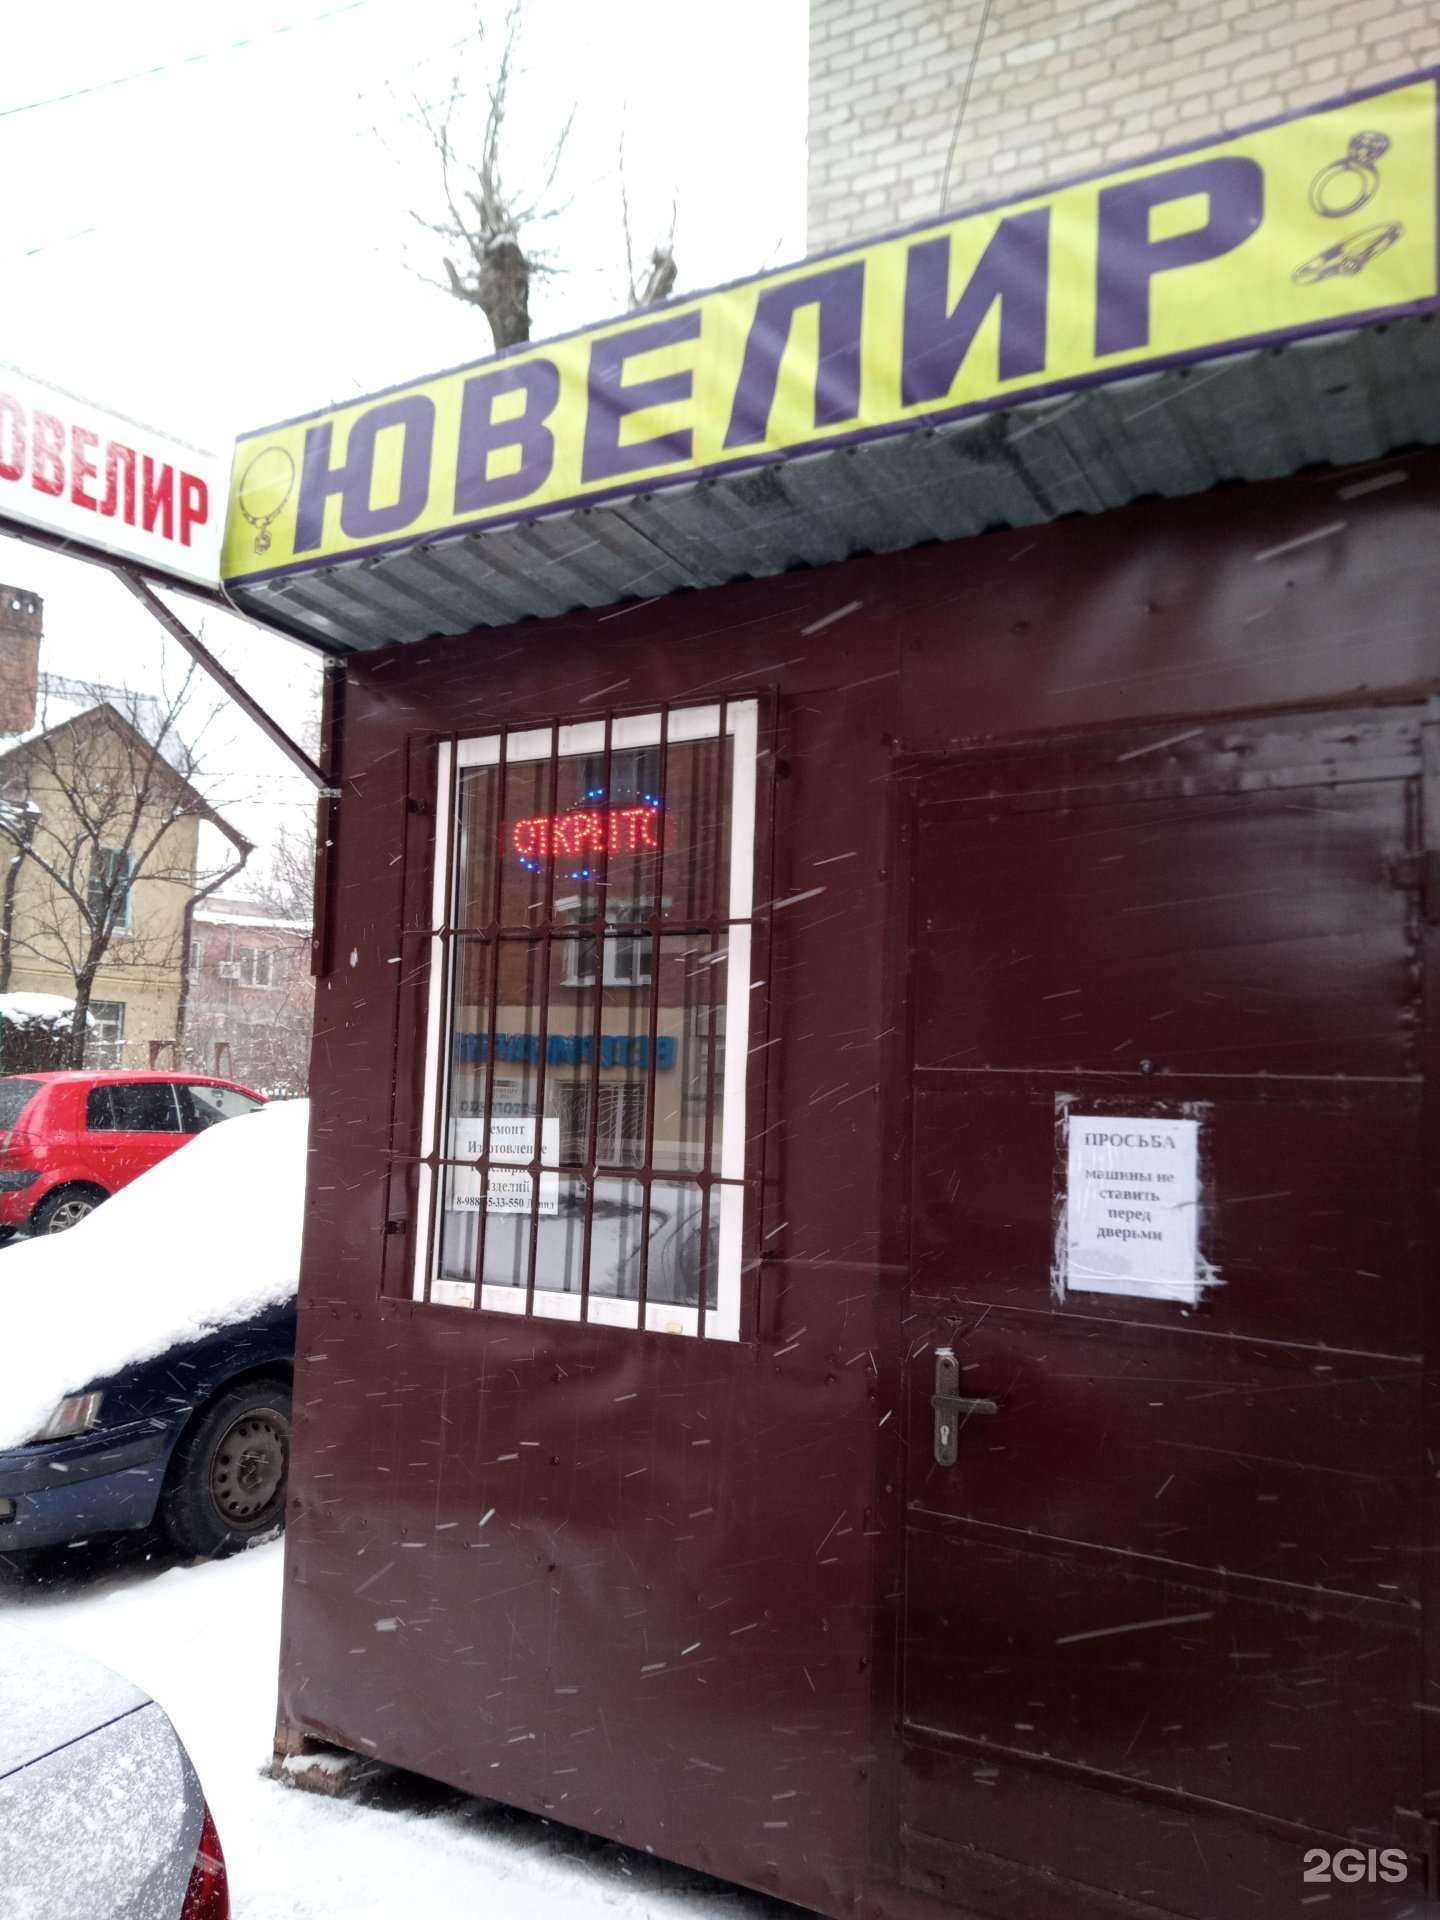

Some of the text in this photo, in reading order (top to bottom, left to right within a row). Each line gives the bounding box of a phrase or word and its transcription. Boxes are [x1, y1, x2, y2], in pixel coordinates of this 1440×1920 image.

[293, 154, 1264, 555] ЮВЕЛИР
[489, 1125, 525, 1135] емонт
[1085, 1132, 1176, 1149] ПРОСЬБА
[1085, 1169, 1175, 1183] машины не
[1099, 1188, 1160, 1201] ставить
[1108, 1208, 1151, 1223] перед
[1096, 1226, 1162, 1242] дверьми
